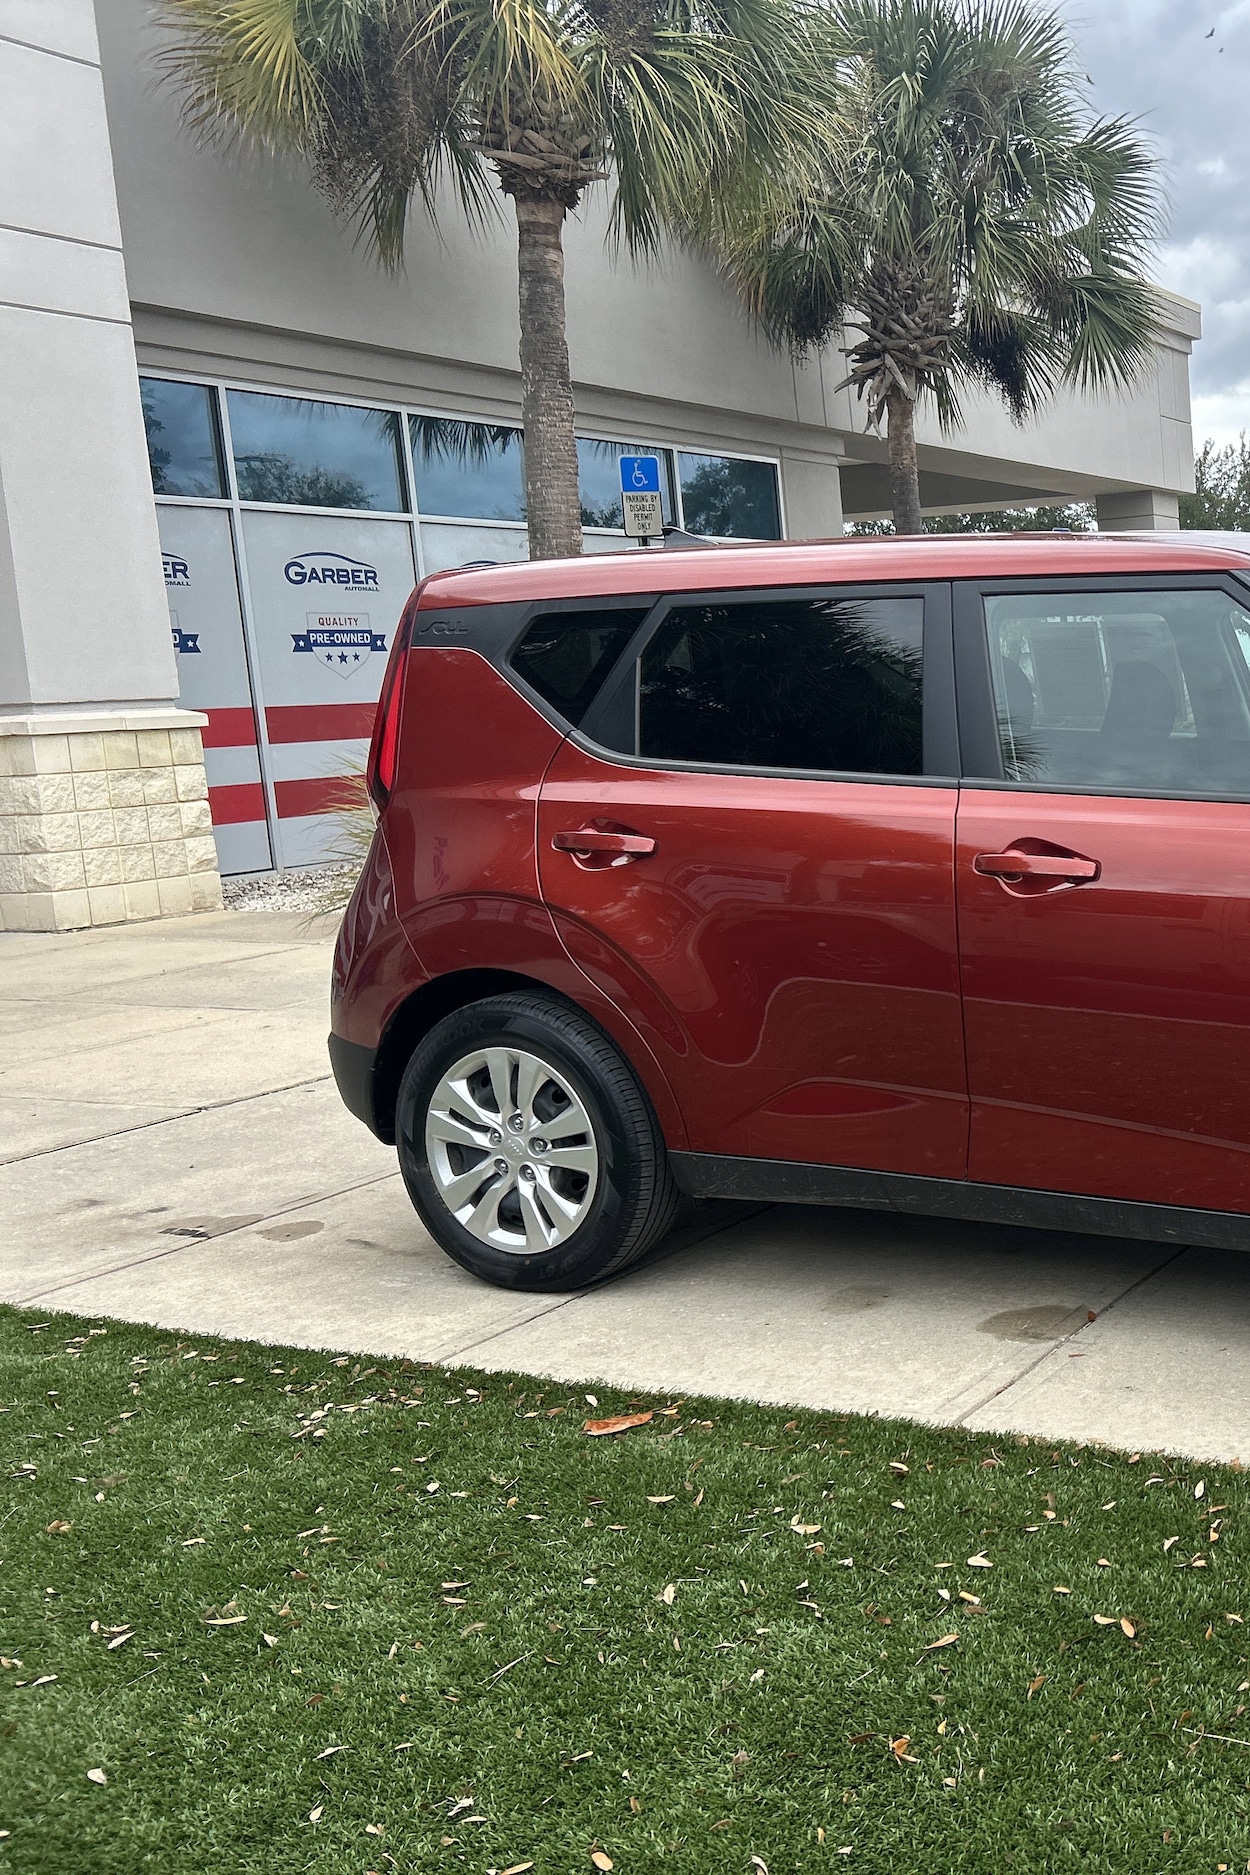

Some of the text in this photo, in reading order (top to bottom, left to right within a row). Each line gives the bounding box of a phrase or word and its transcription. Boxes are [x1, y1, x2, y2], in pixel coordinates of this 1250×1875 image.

[625, 494, 658, 503] PARKING BY
[629, 503, 656, 512] DISABLED
[633, 513, 653, 521] PERMIT
[637, 522, 651, 530] ONLY
[284, 561, 379, 585] GARBER
[318, 617, 359, 626] QUALITY
[309, 632, 371, 644] PRE-OWNED
